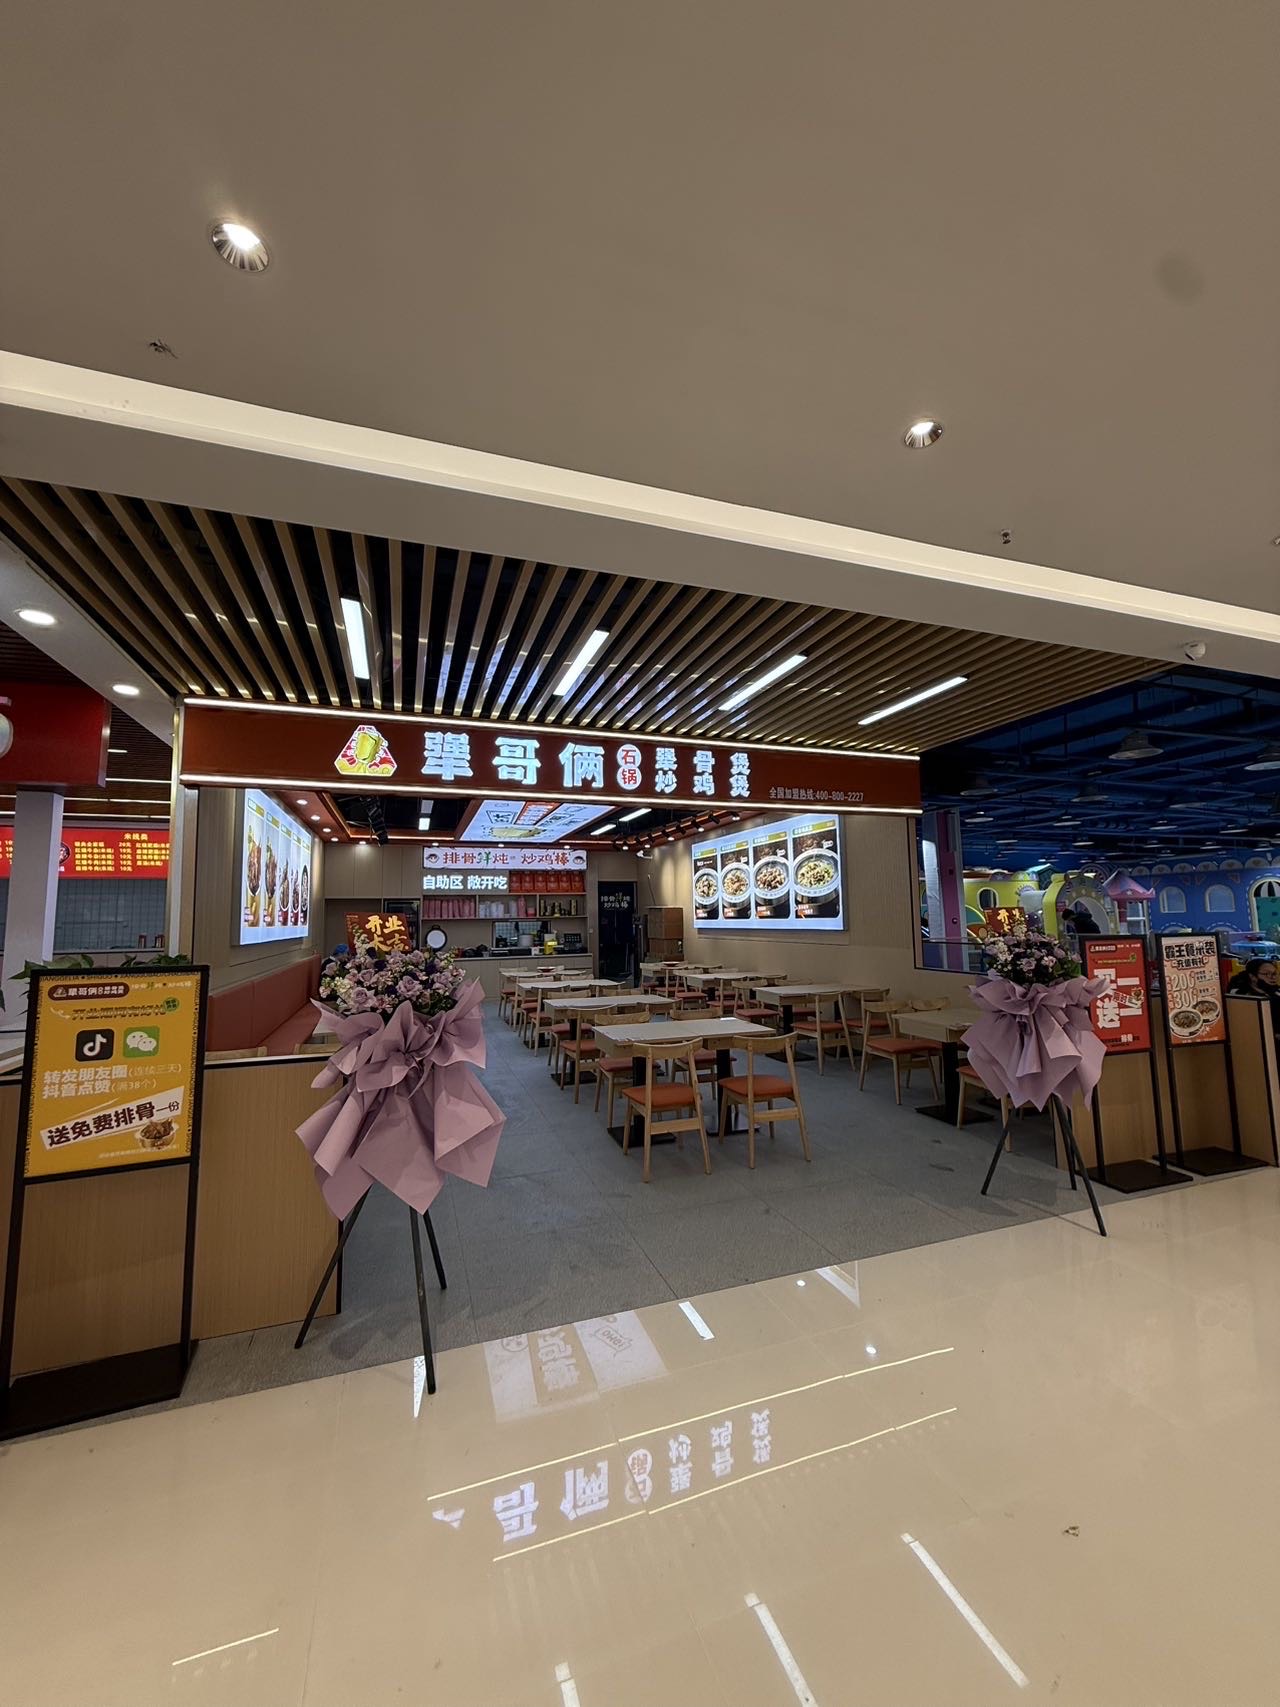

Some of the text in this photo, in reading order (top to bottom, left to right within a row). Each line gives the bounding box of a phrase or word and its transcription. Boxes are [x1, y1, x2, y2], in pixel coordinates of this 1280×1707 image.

[421, 731, 605, 788] 犟哥俩
[621, 748, 638, 785] 石锅
[423, 875, 463, 890] 自助区
[467, 875, 508, 890] 敞开吃
[365, 915, 405, 935] 开业
